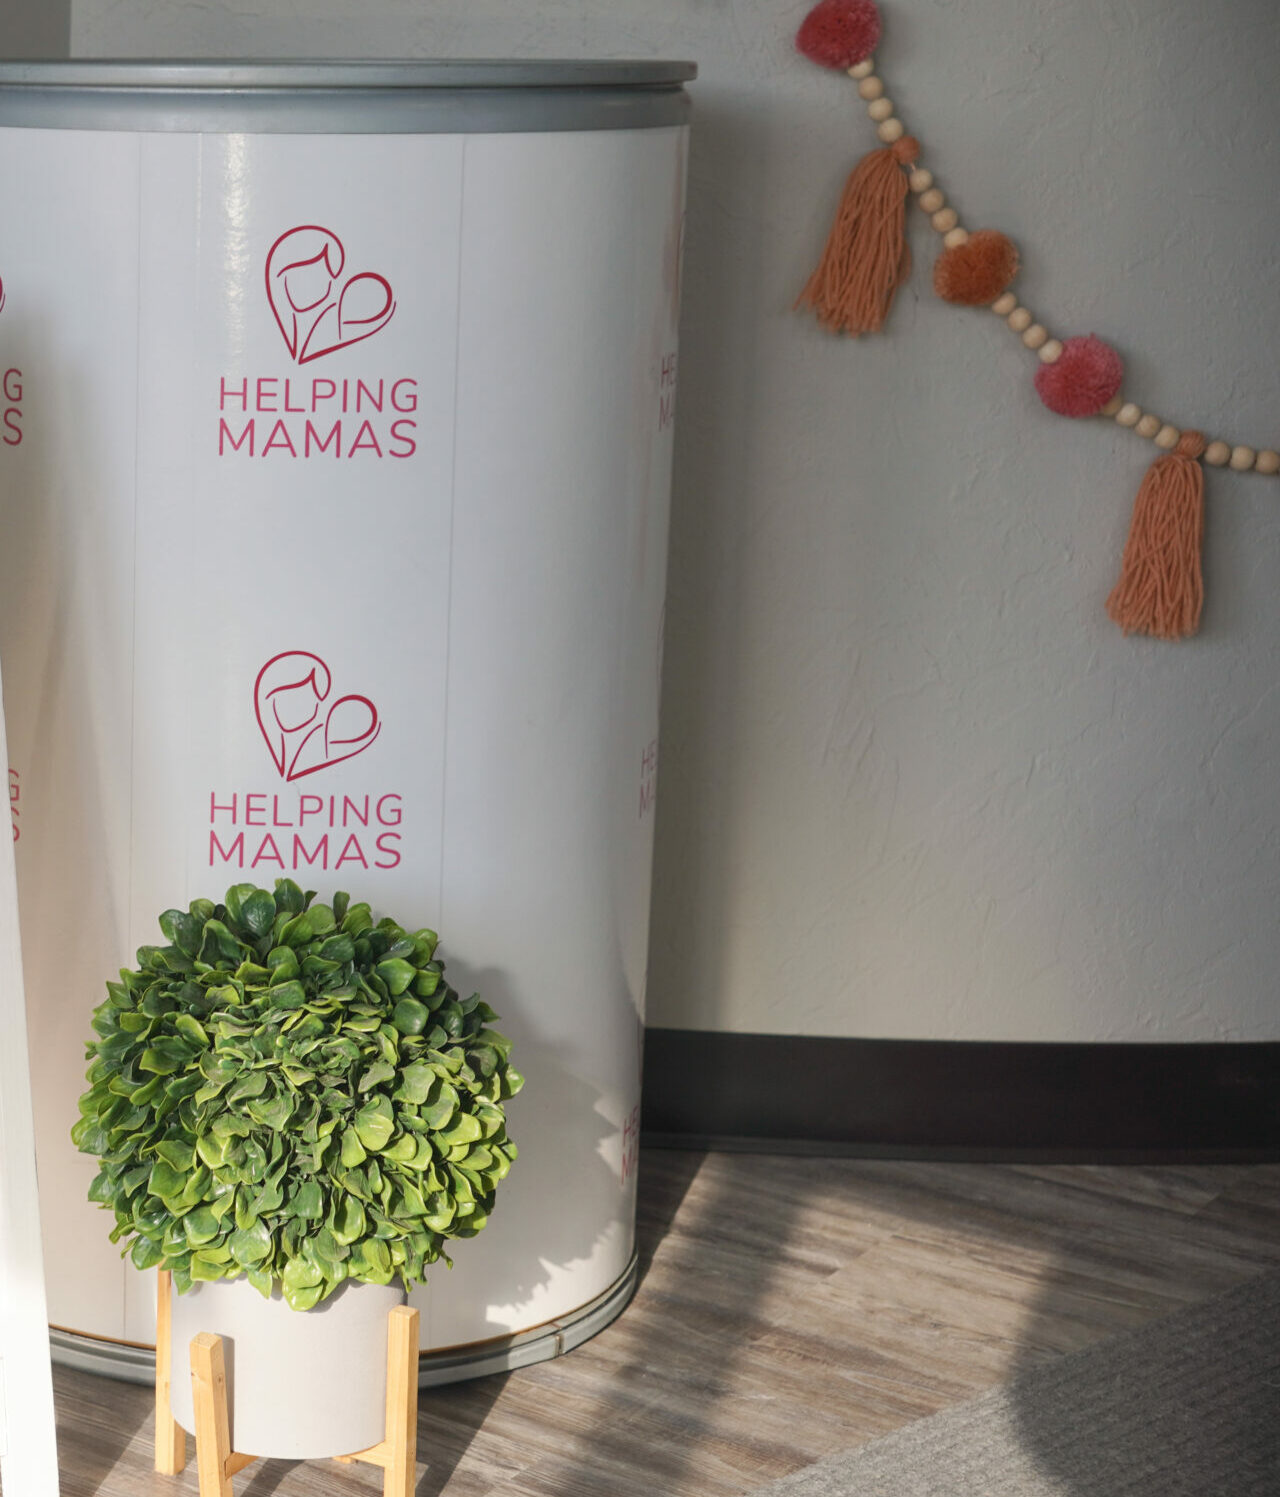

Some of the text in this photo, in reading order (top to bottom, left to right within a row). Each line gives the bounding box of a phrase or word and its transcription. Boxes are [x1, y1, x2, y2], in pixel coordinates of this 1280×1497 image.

[219, 376, 418, 413] HELPING
[219, 417, 417, 459] MAMAS
[210, 791, 402, 828] HELPING
[209, 829, 401, 871] MAMAS
